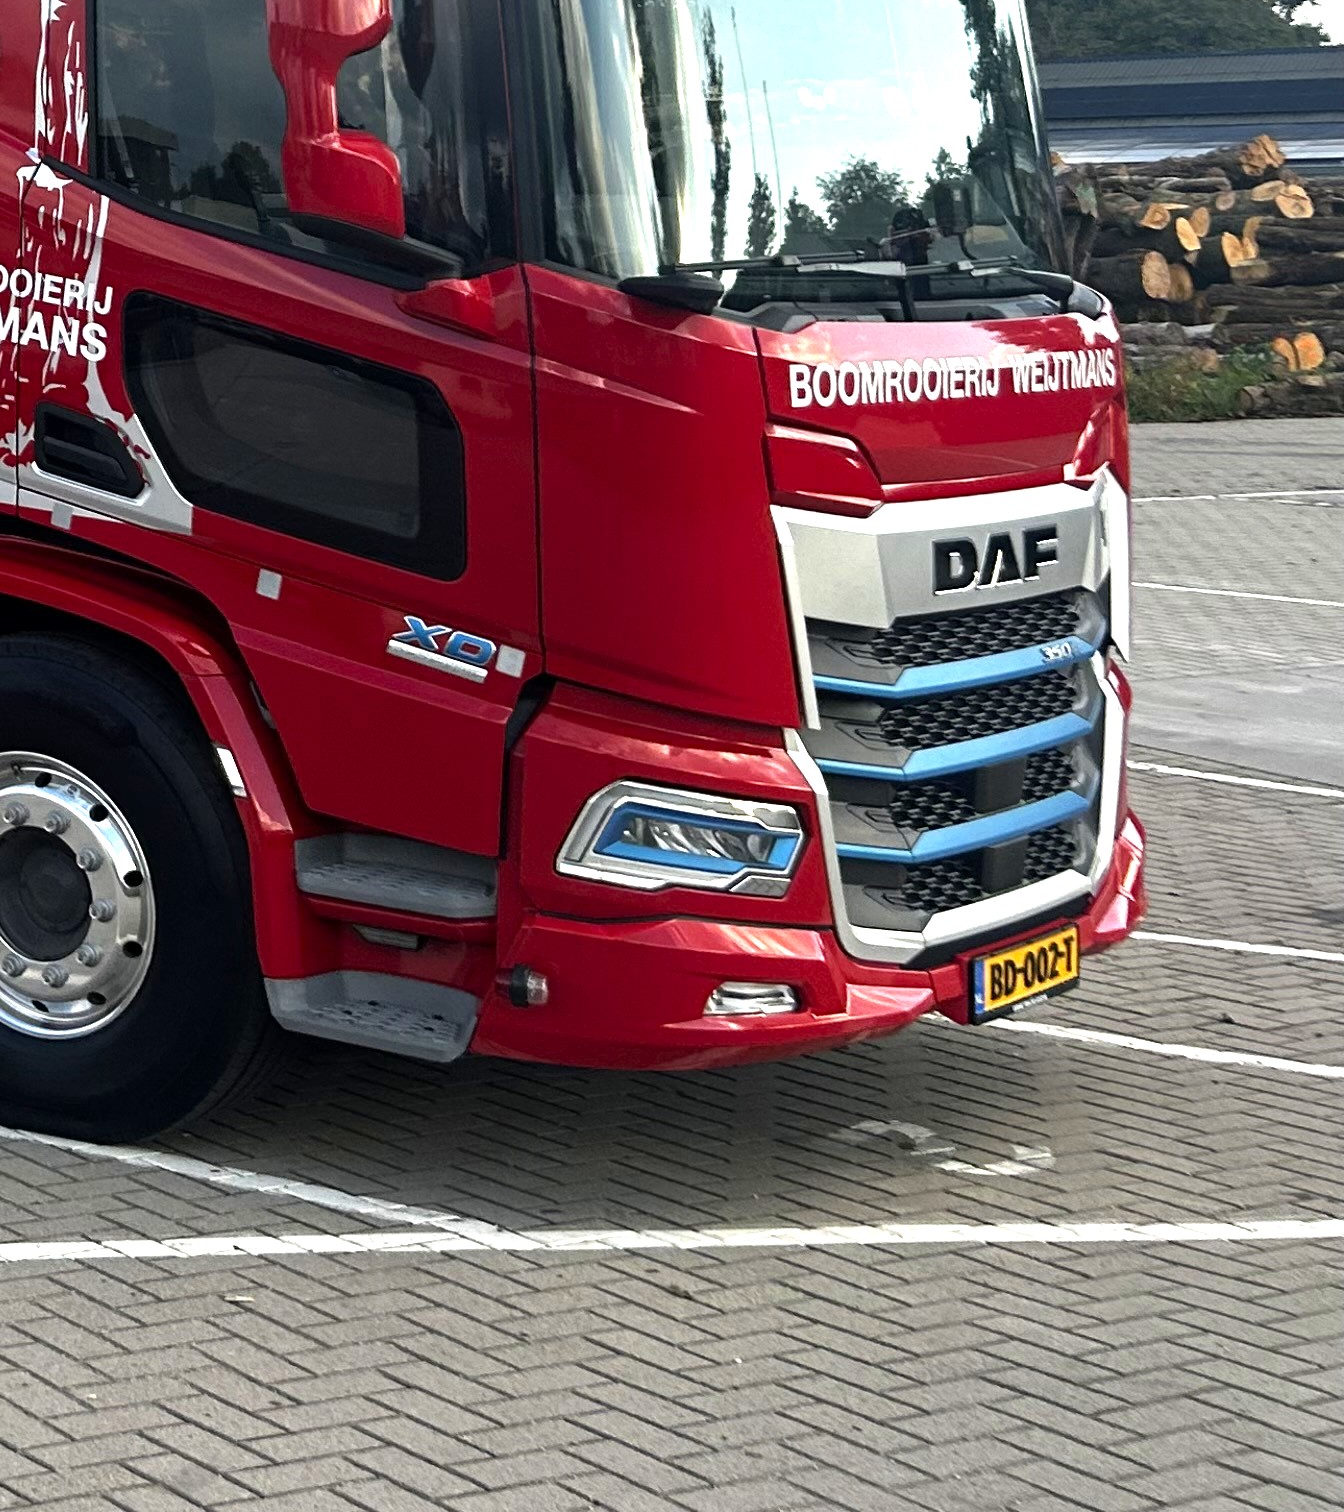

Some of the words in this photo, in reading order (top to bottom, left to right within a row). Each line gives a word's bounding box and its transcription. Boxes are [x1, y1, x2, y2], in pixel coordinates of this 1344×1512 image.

[789, 355, 1001, 408] BOOMROOIERIJ
[1008, 348, 1116, 394] WEIJTMANS
[931, 523, 1059, 596] DAF
[990, 935, 1075, 1001] BD-002-T
